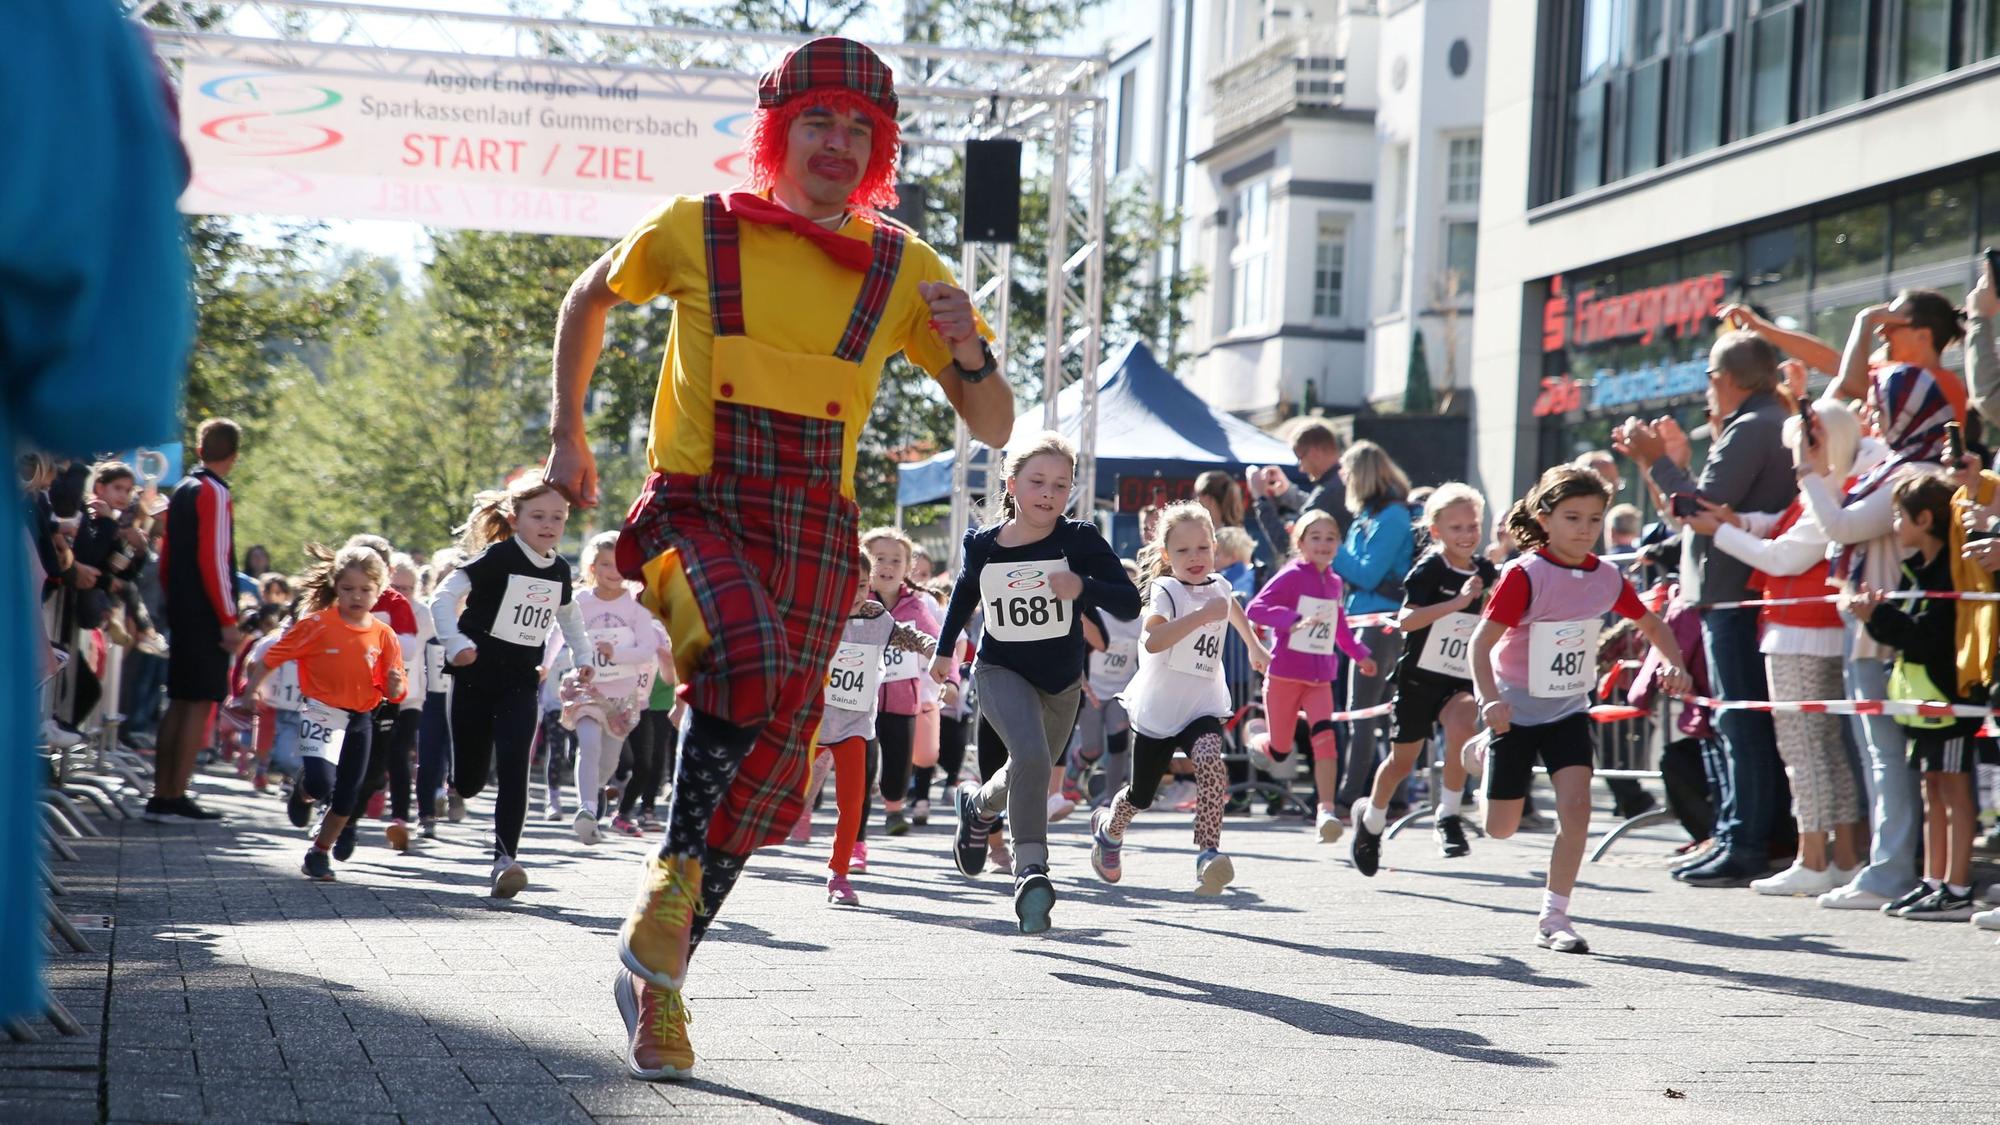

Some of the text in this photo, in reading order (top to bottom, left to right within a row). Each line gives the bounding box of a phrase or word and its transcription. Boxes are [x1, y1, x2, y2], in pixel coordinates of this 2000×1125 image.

[425, 69, 639, 100] AggerEnergie- und
[360, 95, 699, 138] Sparkassenlauf Gummersbach
[401, 132, 655, 182] START / ZIEL
[1573, 271, 1726, 346] Finanzgruppe
[513, 603, 552, 629] 1018
[991, 596, 1064, 626] 1681
[1193, 634, 1220, 659] 464
[1104, 652, 1128, 669] 709
[1550, 650, 1586, 676] 487
[830, 667, 864, 692] 504
[831, 694, 858, 706] Sainab
